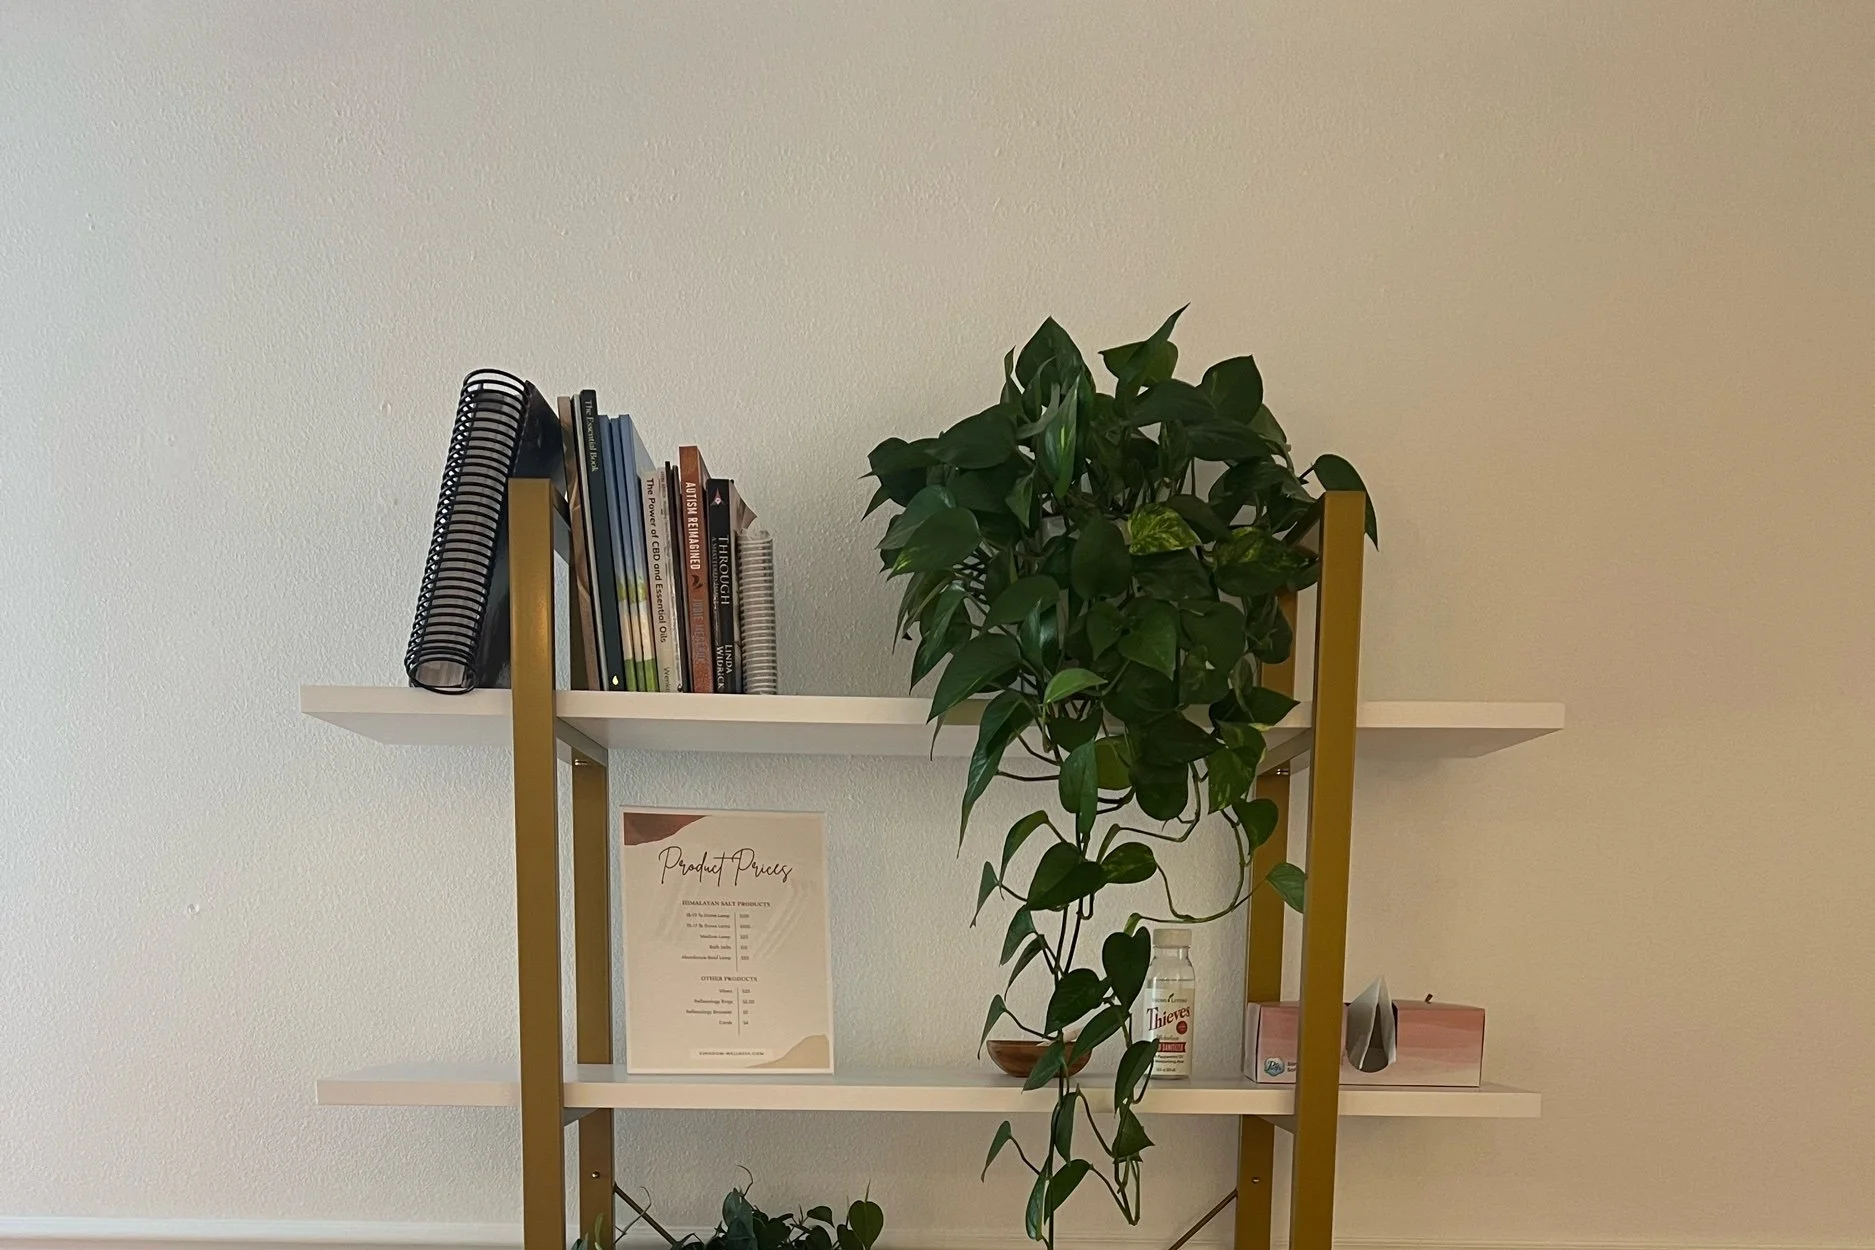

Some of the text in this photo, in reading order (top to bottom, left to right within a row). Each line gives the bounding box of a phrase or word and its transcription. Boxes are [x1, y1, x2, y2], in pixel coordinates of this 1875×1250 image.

[584, 401, 599, 473] The Essential Book
[646, 478, 668, 643] The Power of CBD and Essential Oils
[685, 481, 701, 570] AUTISM REIMAGINED
[718, 535, 731, 605] THROUGH
[716, 644, 733, 689] LINDA WIDRICK
[658, 845, 793, 887] Product Prices
[1146, 1006, 1191, 1032] Thieves
